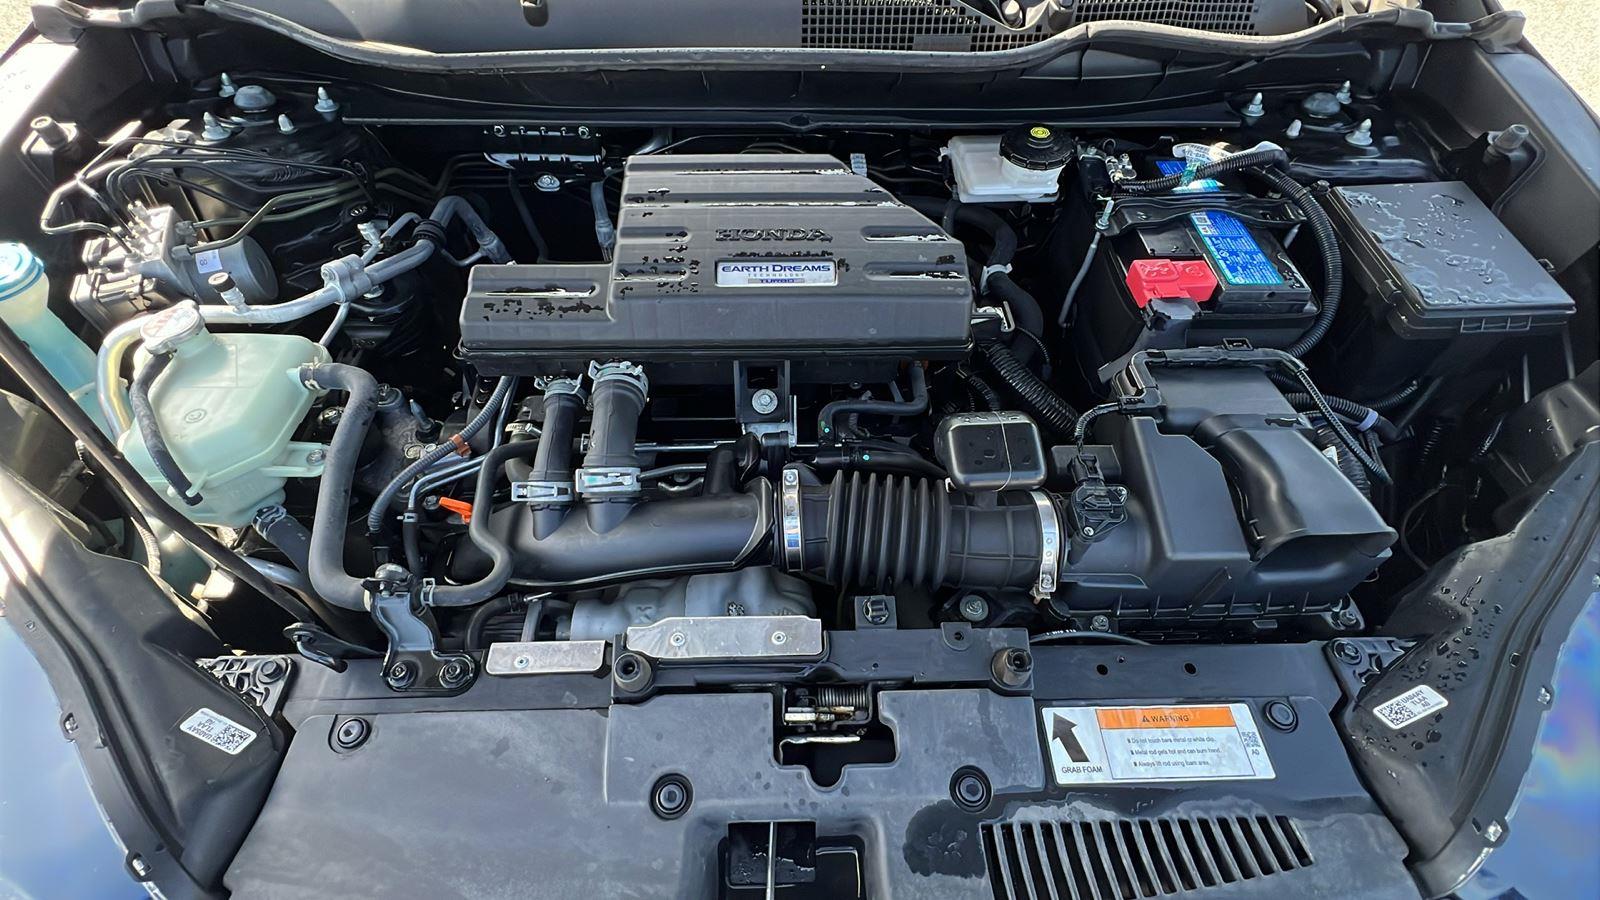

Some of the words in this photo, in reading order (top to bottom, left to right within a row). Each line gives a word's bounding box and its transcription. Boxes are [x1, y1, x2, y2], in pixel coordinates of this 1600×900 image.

[715, 228, 833, 242] HONDA
[722, 264, 769, 272] EARTH
[772, 264, 831, 272] DREAMS
[1061, 766, 1082, 774] GRAB
